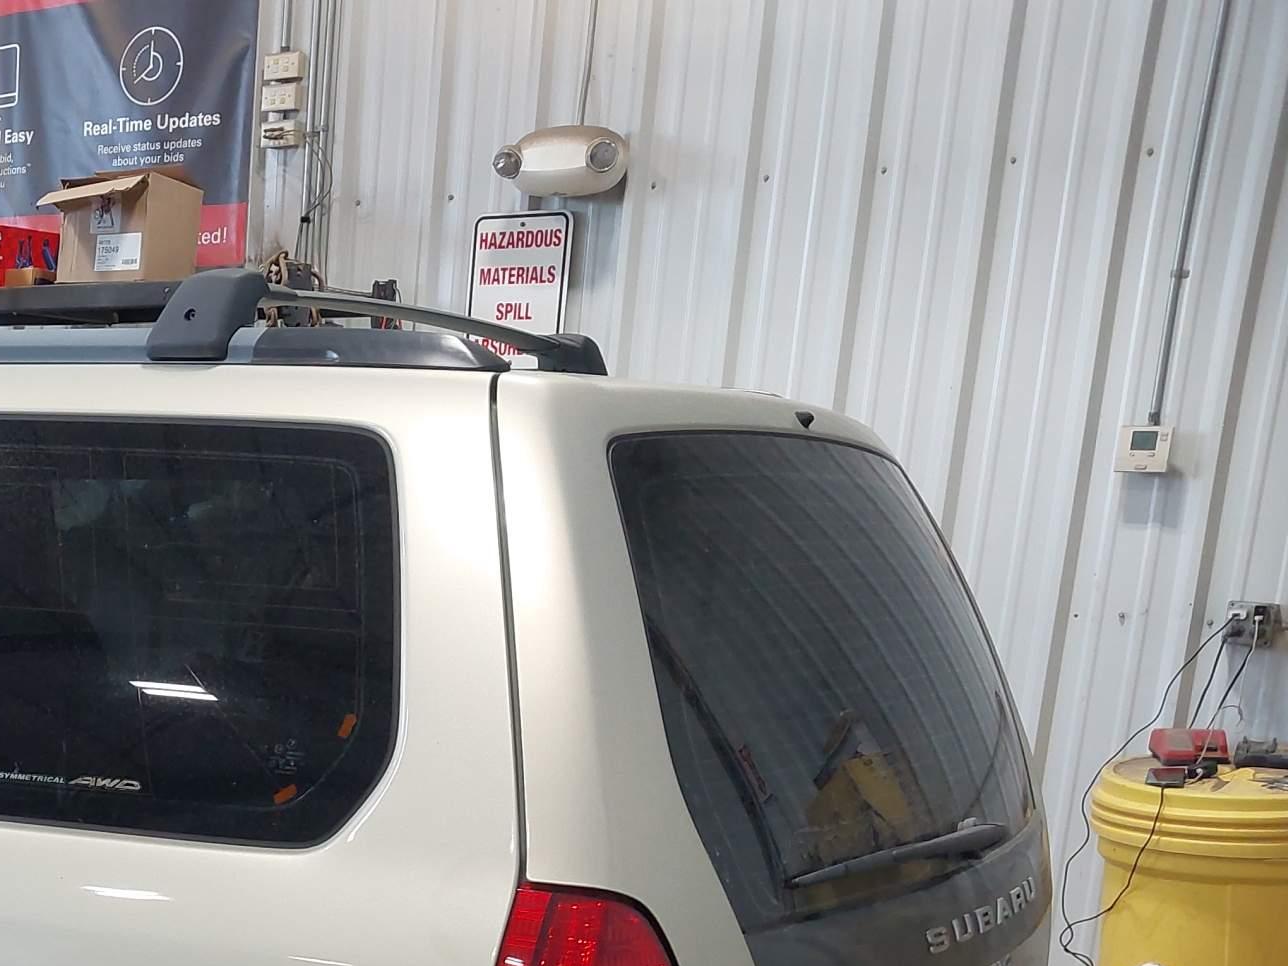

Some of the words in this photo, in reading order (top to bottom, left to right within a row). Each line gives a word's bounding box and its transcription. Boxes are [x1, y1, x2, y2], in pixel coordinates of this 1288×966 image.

[83, 117, 152, 137] Real-Time
[157, 112, 221, 132] Updates
[4, 129, 34, 145] Easy
[97, 143, 131, 155] Receive
[133, 141, 161, 152] status
[164, 138, 202, 151] updates
[0, 152, 14, 163] bid,
[112, 156, 138, 167] about
[140, 154, 161, 166] your
[164, 152, 184, 163] bids
[479, 228, 562, 250] HAZARDOUS
[479, 265, 556, 286] MATERIALS
[495, 302, 532, 321] SPILL
[67, 776, 142, 791] AWD
[925, 876, 1036, 954] SUBARU
